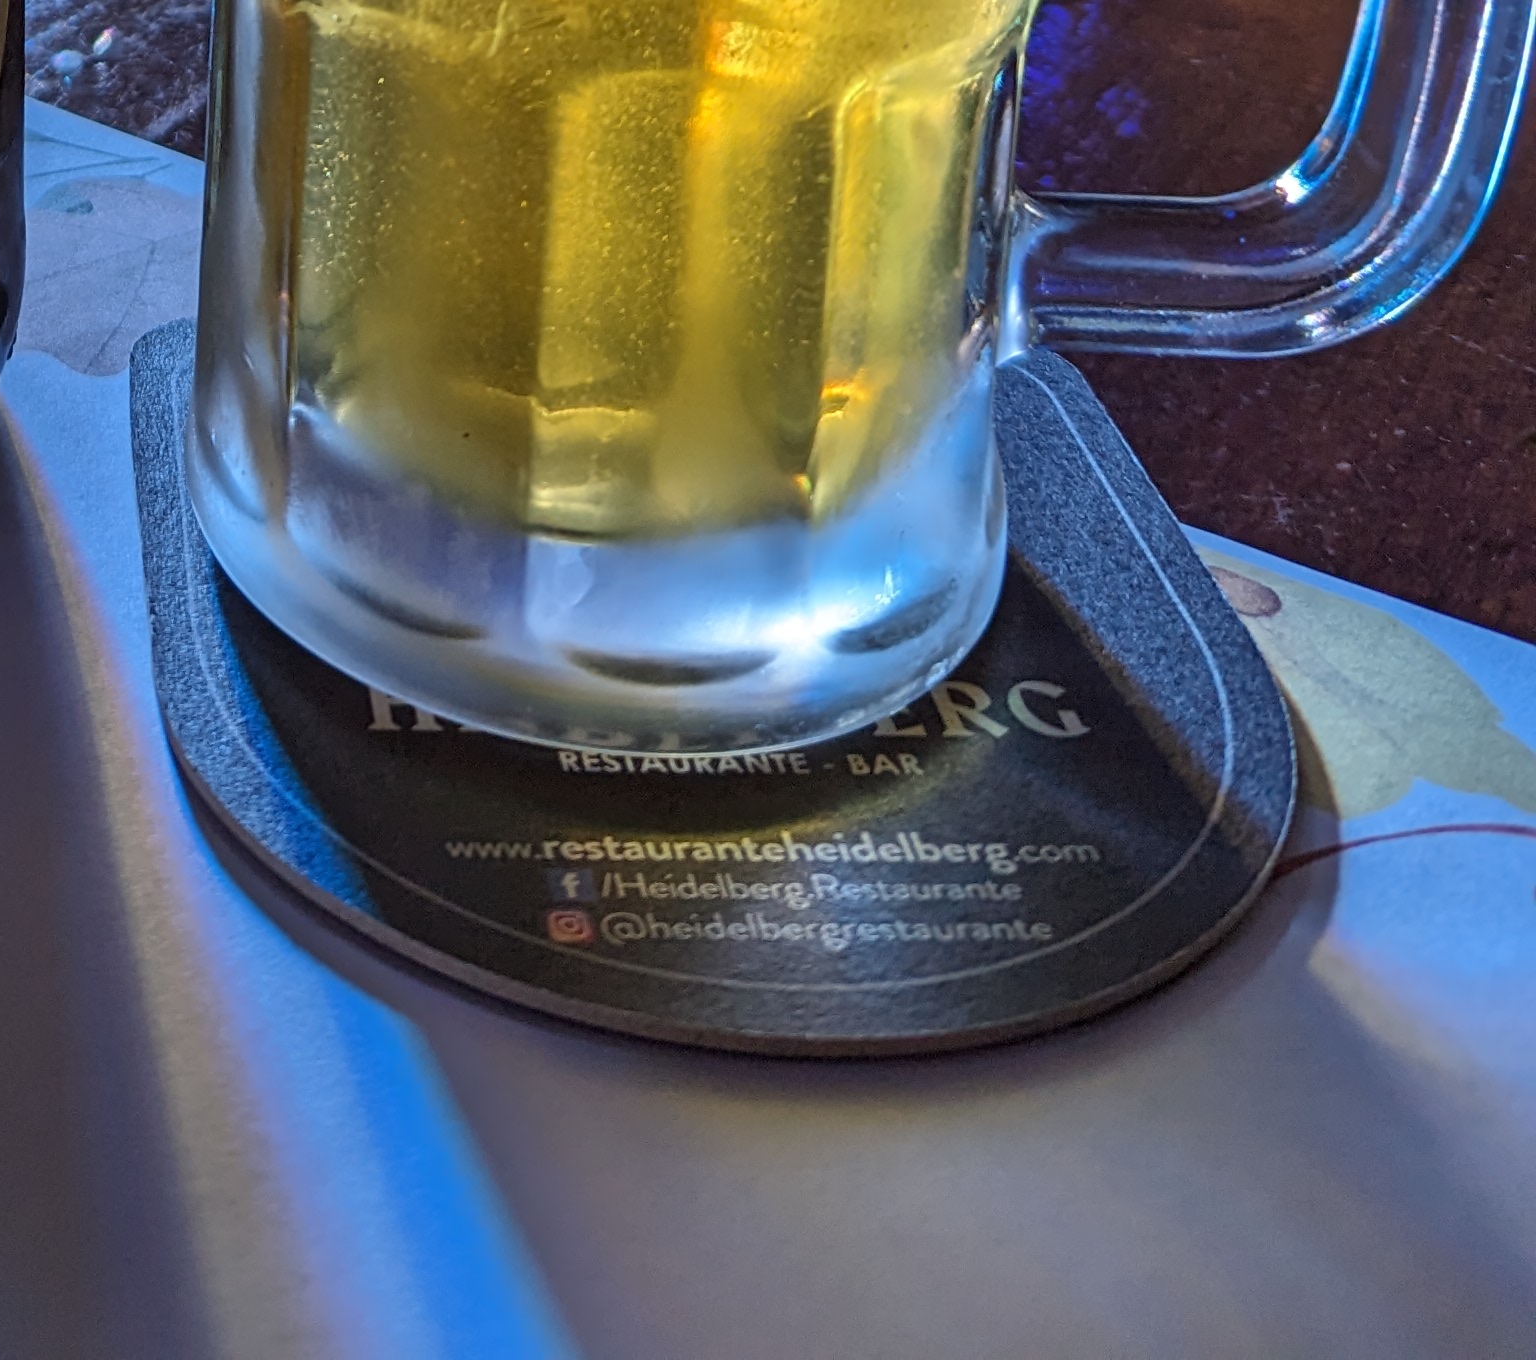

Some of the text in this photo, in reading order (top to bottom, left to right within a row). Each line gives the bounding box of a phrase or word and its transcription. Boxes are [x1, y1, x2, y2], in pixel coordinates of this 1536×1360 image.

[846, 753, 925, 776] BAR
[445, 830, 1100, 875] www.restauranteheidelberg.com
[599, 911, 1054, 953] @heidelbergrestaurante
